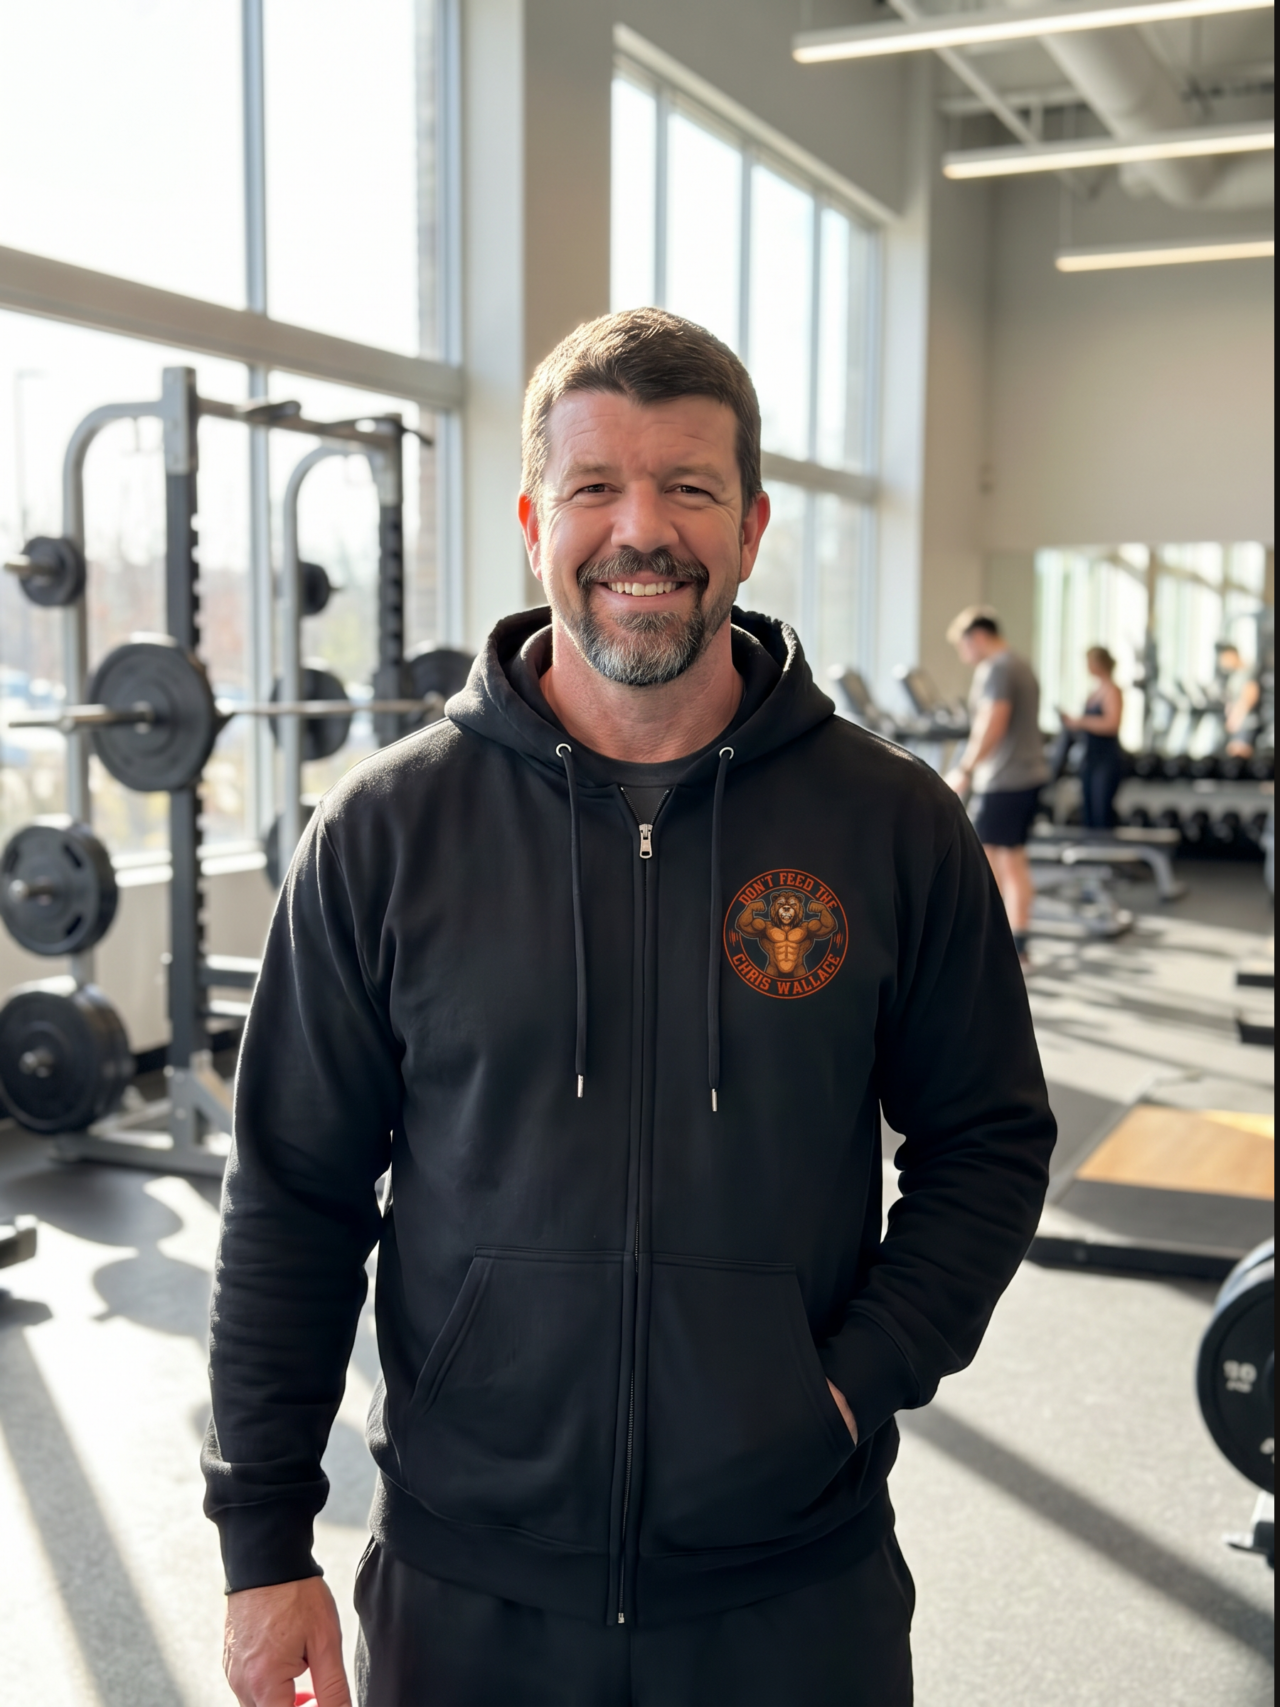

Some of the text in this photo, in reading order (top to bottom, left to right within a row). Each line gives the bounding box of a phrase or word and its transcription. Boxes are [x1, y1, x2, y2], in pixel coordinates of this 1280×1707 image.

[738, 872, 838, 910] DON'T FEED THE
[732, 953, 840, 995] CHRIS WALLACE
